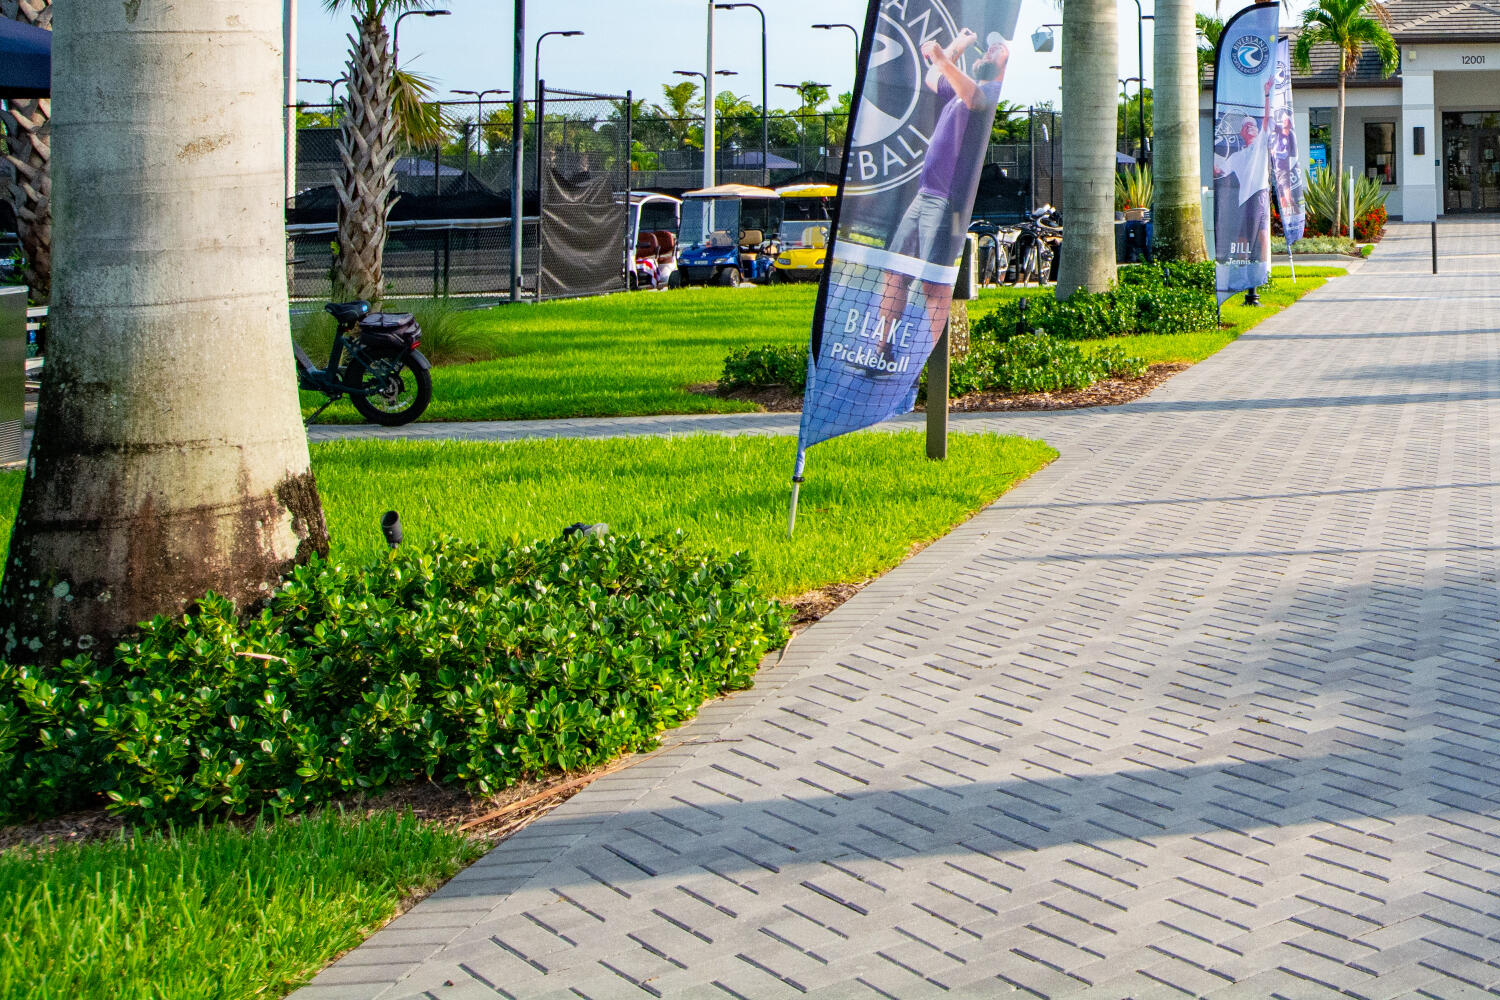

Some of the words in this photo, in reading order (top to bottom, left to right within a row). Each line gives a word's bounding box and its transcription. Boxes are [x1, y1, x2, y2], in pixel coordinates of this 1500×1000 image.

[1461, 55, 1486, 65] 12001
[1230, 242, 1252, 254] BILL
[1228, 257, 1251, 265] Tennis
[844, 308, 915, 349] BLAKE
[830, 342, 910, 373] Pickleball
